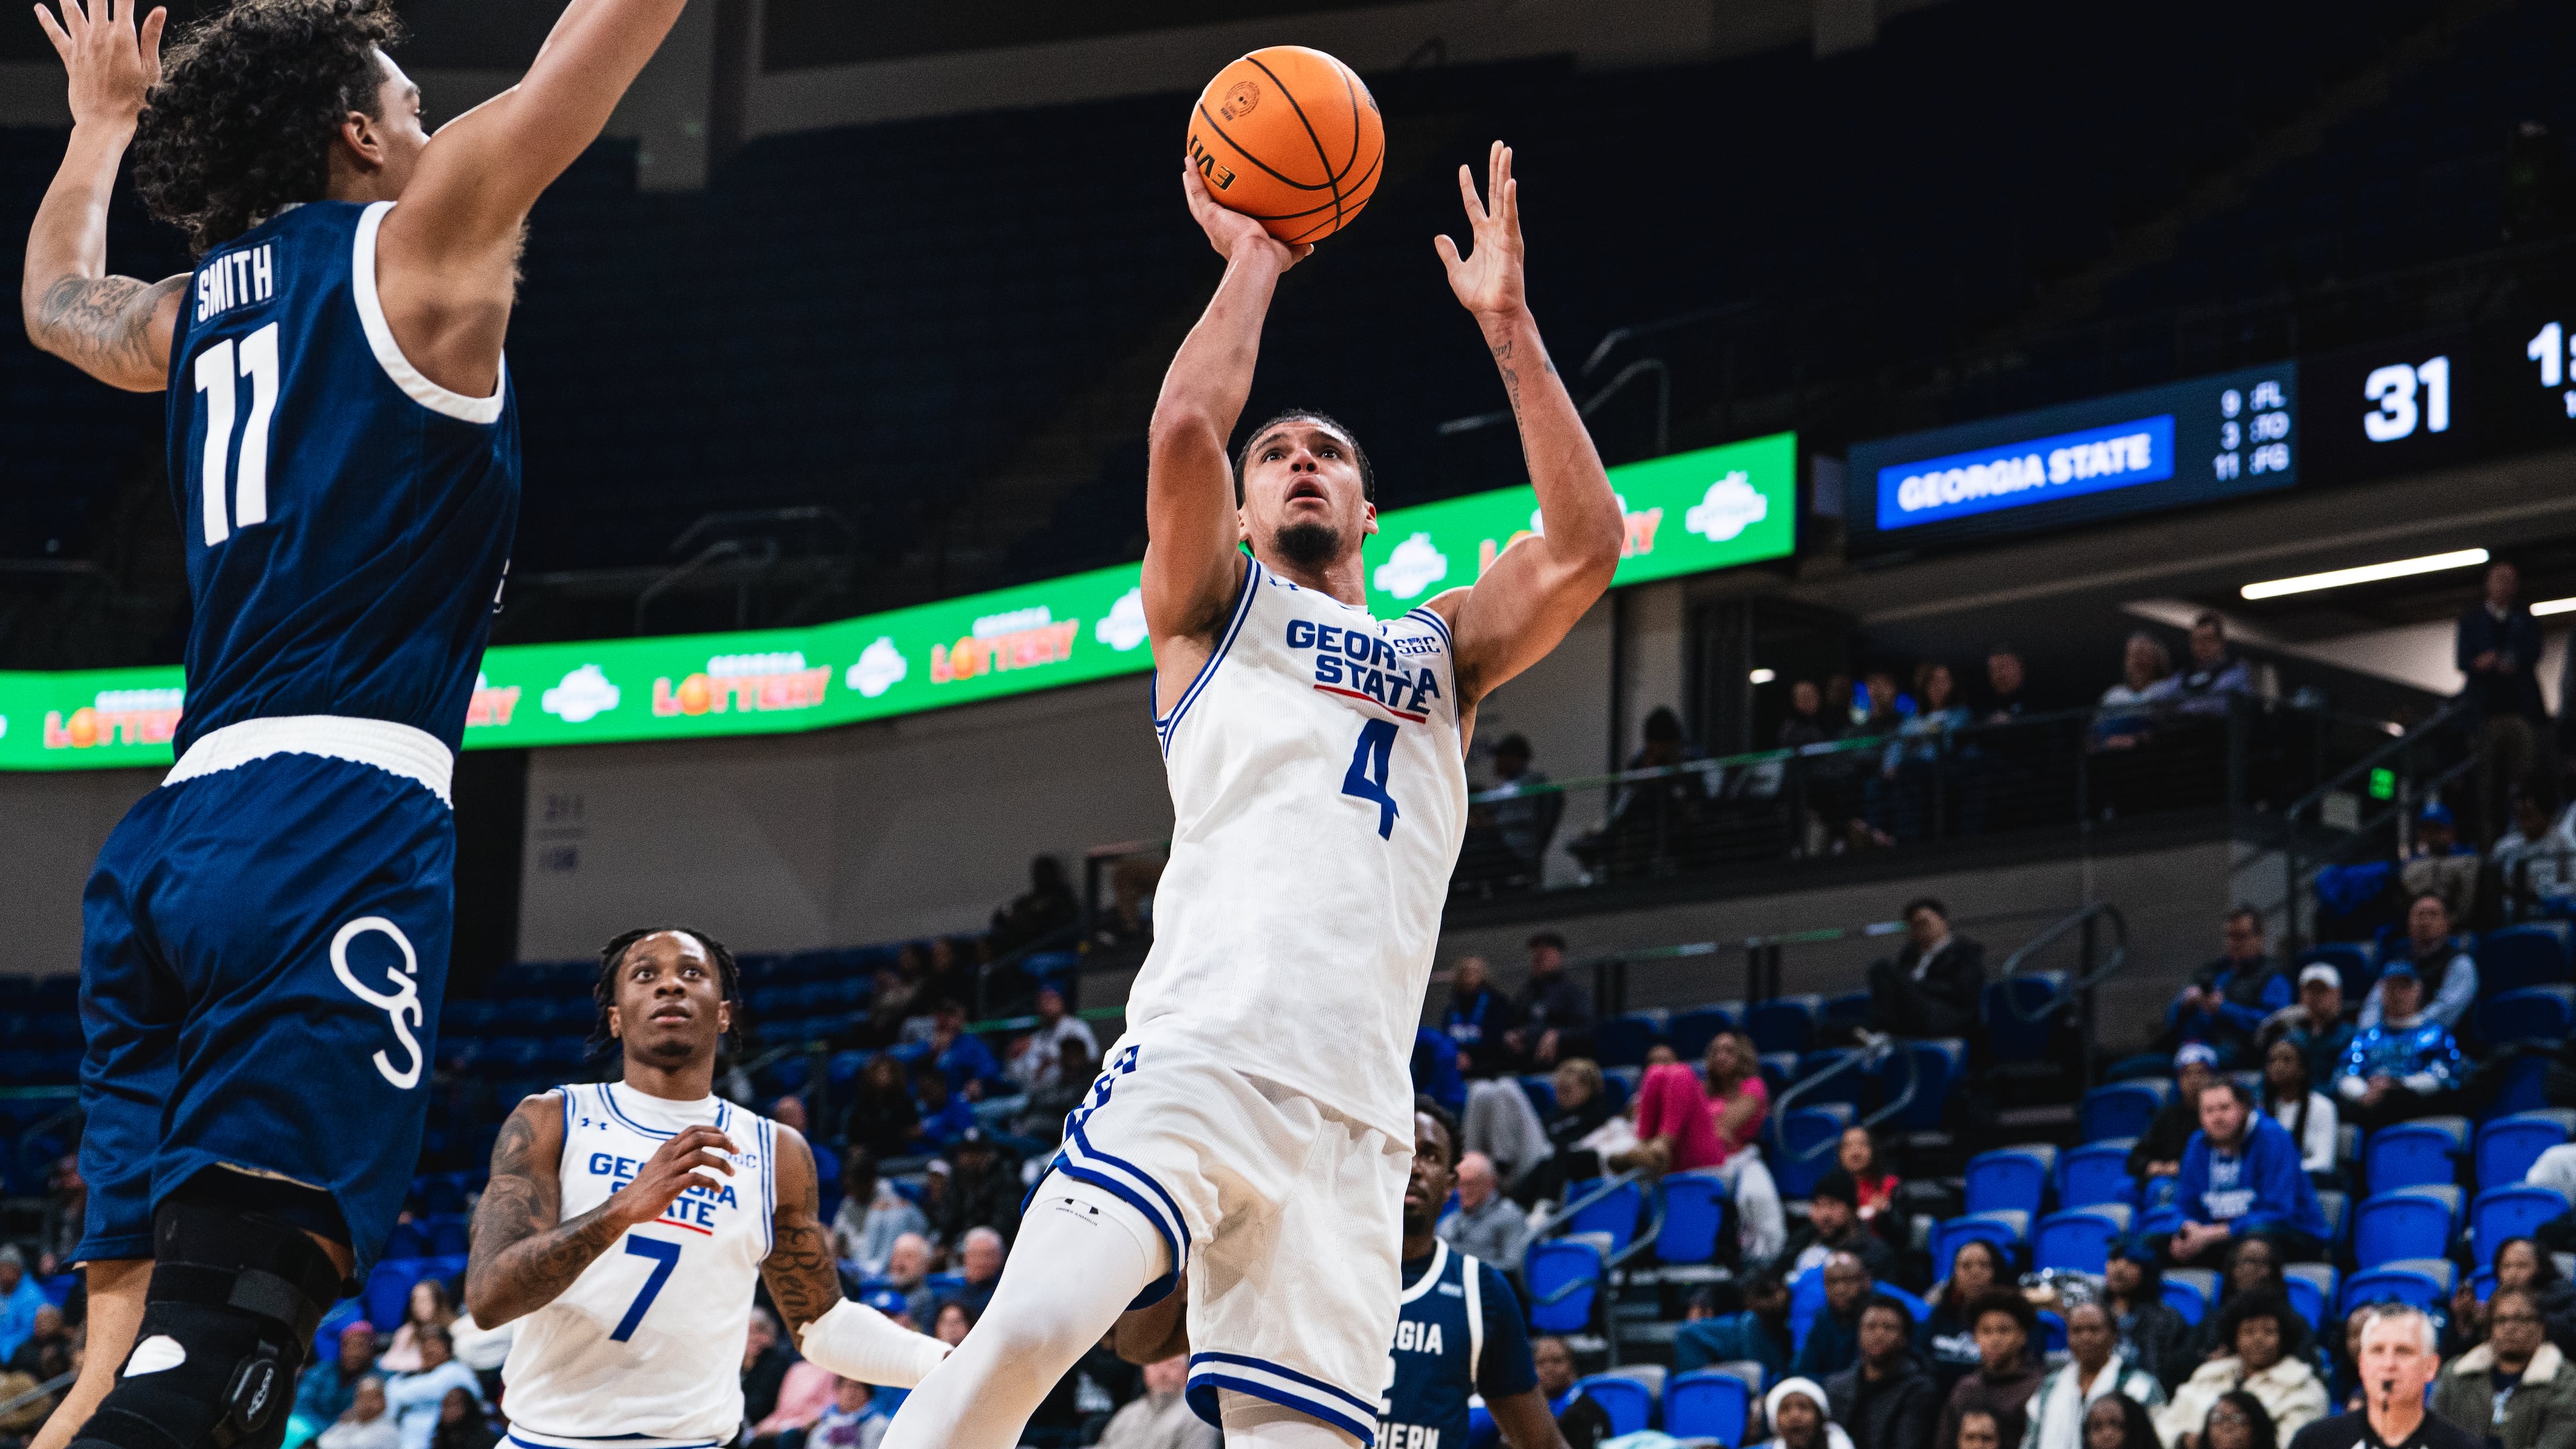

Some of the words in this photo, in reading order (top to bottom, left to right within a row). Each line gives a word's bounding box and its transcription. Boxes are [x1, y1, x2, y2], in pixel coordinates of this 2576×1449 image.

[197, 244, 274, 323] SMITH
[2364, 354, 2451, 443] 31
[195, 322, 280, 547] 11
[2213, 451, 2239, 481] 11
[2221, 420, 2241, 449] 3
[1897, 453, 2046, 512] GEORGIA
[2048, 433, 2151, 484] STATE
[930, 618, 1079, 684] LOTTERY
[1393, 635, 1442, 655] SBC
[652, 664, 833, 717] LOTTERY
[1316, 653, 1430, 714] STATE
[44, 707, 182, 749] LOTTE
[1342, 718, 1399, 841] 4
[329, 916, 423, 1090] GS
[609, 1234, 682, 1343] 7
[1391, 1320, 1443, 1356] GIA
